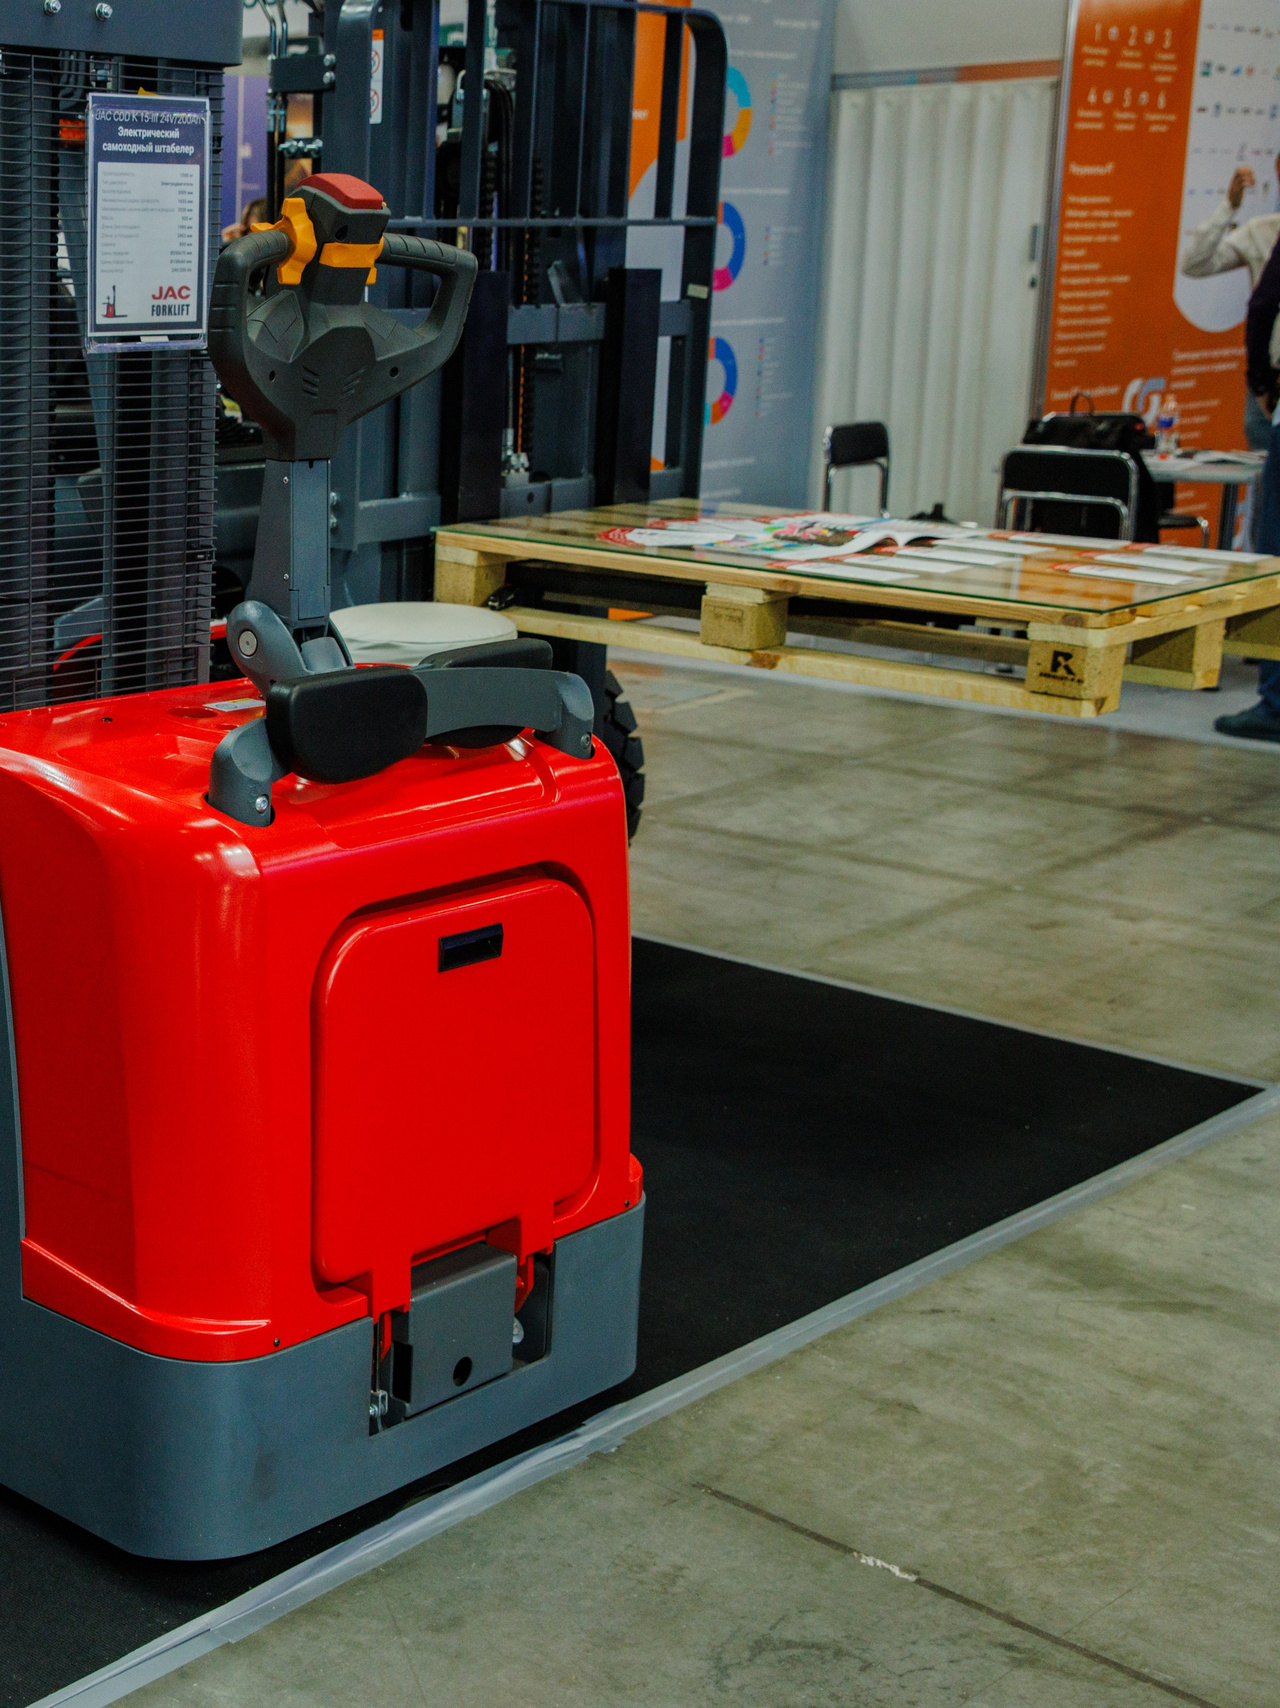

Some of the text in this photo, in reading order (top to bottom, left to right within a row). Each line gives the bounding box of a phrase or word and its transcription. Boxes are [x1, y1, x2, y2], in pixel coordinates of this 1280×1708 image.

[95, 110, 112, 121] JAC
[117, 126, 180, 139] Электрический
[102, 142, 195, 156] самоходный штабелер
[151, 285, 191, 300] JAC
[151, 303, 191, 317] FORKLIFT
